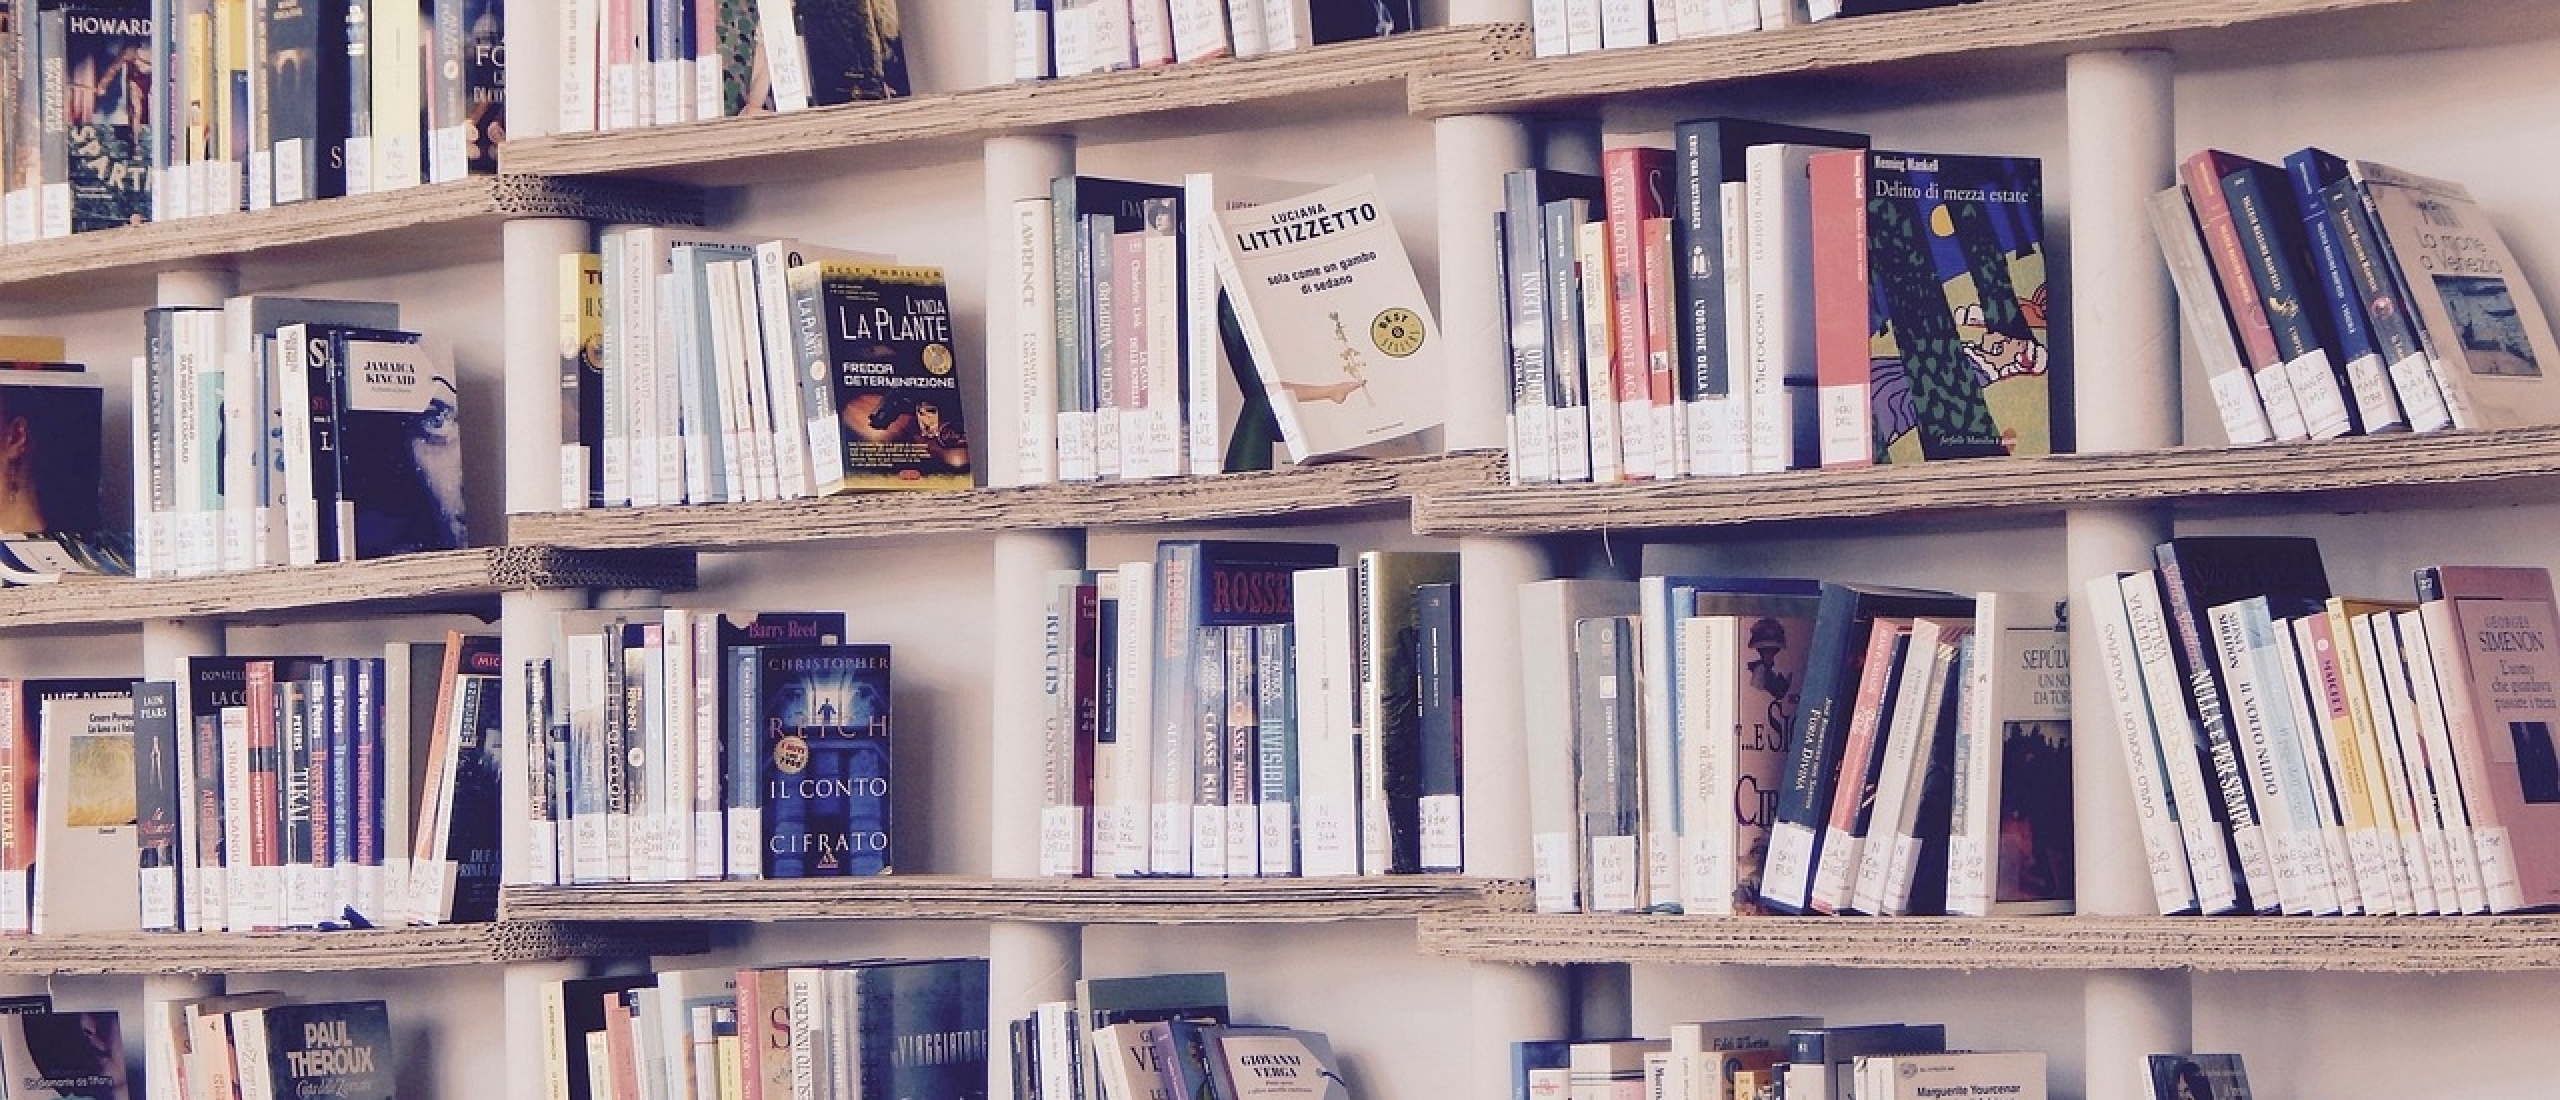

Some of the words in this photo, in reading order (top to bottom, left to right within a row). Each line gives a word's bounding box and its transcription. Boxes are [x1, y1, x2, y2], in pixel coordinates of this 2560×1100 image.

[1875, 179, 1921, 199] Delitto
[1925, 181, 1939, 199] di
[1943, 189, 1985, 201] mezza
[1989, 190, 2029, 203] estate
[1271, 203, 1327, 225] LUCIANA
[1237, 203, 1377, 252] LITTIZZETTO
[1292, 267, 1321, 281] come
[1323, 263, 1338, 273] un
[1339, 251, 1377, 271] gambo
[1301, 283, 1312, 295] di
[1313, 275, 1353, 292] sedano
[839, 304, 872, 340] LA
[874, 306, 950, 342] PLANTE
[843, 375, 955, 389] DETERMINAZIONE
[2478, 631, 2545, 652] SIMENON
[768, 656, 889, 671] CHRISTOPHER
[2189, 669, 2223, 728] NULLA
[769, 714, 888, 739] REICH
[770, 780, 791, 799] IL
[799, 777, 887, 799] CONTO
[769, 831, 888, 855] CIFRATO
[303, 1020, 353, 1048] PAUL
[287, 1045, 375, 1079] THEROUX
[1916, 1085, 1969, 1099] Marguerite
[1969, 1084, 2021, 1095] Yourcenar
